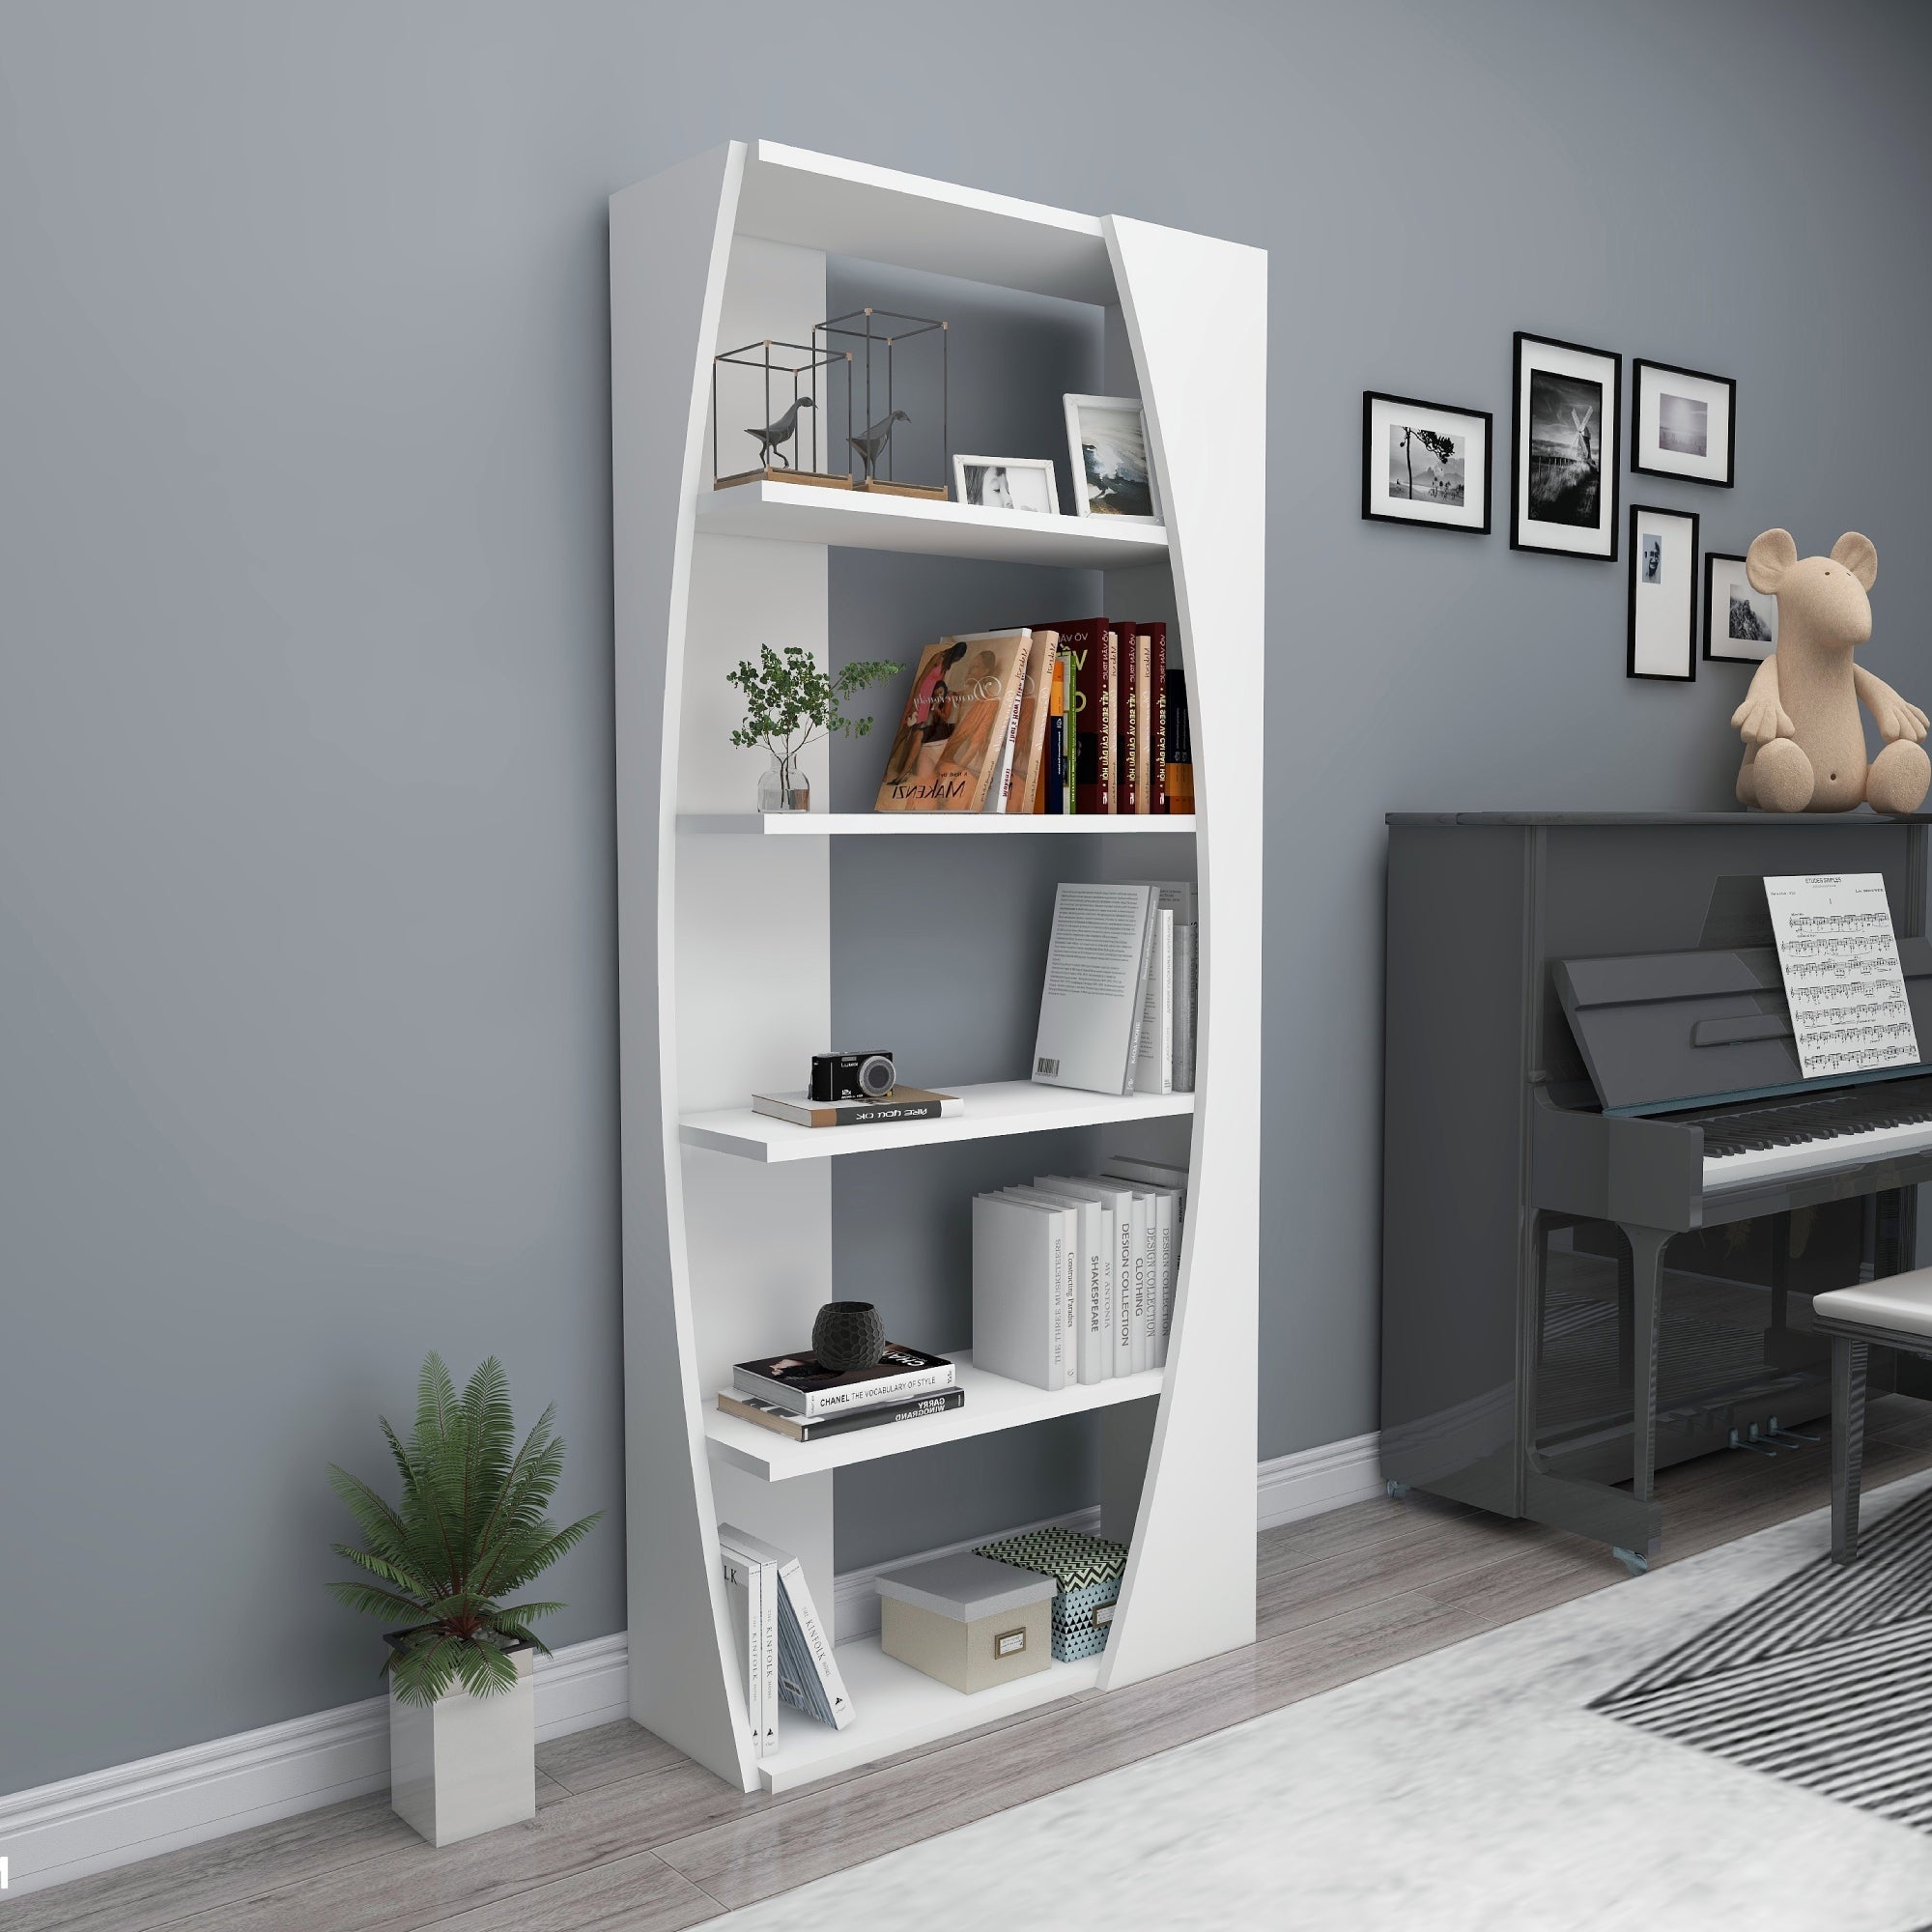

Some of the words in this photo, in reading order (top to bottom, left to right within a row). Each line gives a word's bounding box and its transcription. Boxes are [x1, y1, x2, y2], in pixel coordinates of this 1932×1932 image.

[1147, 1270, 1155, 1338] COLLECTION
[820, 1394, 850, 1407] CHANEL
[866, 1383, 906, 1398] VOCABULARY
[918, 1377, 936, 1387] STYLE
[806, 1619, 826, 1661] KINFOLK
